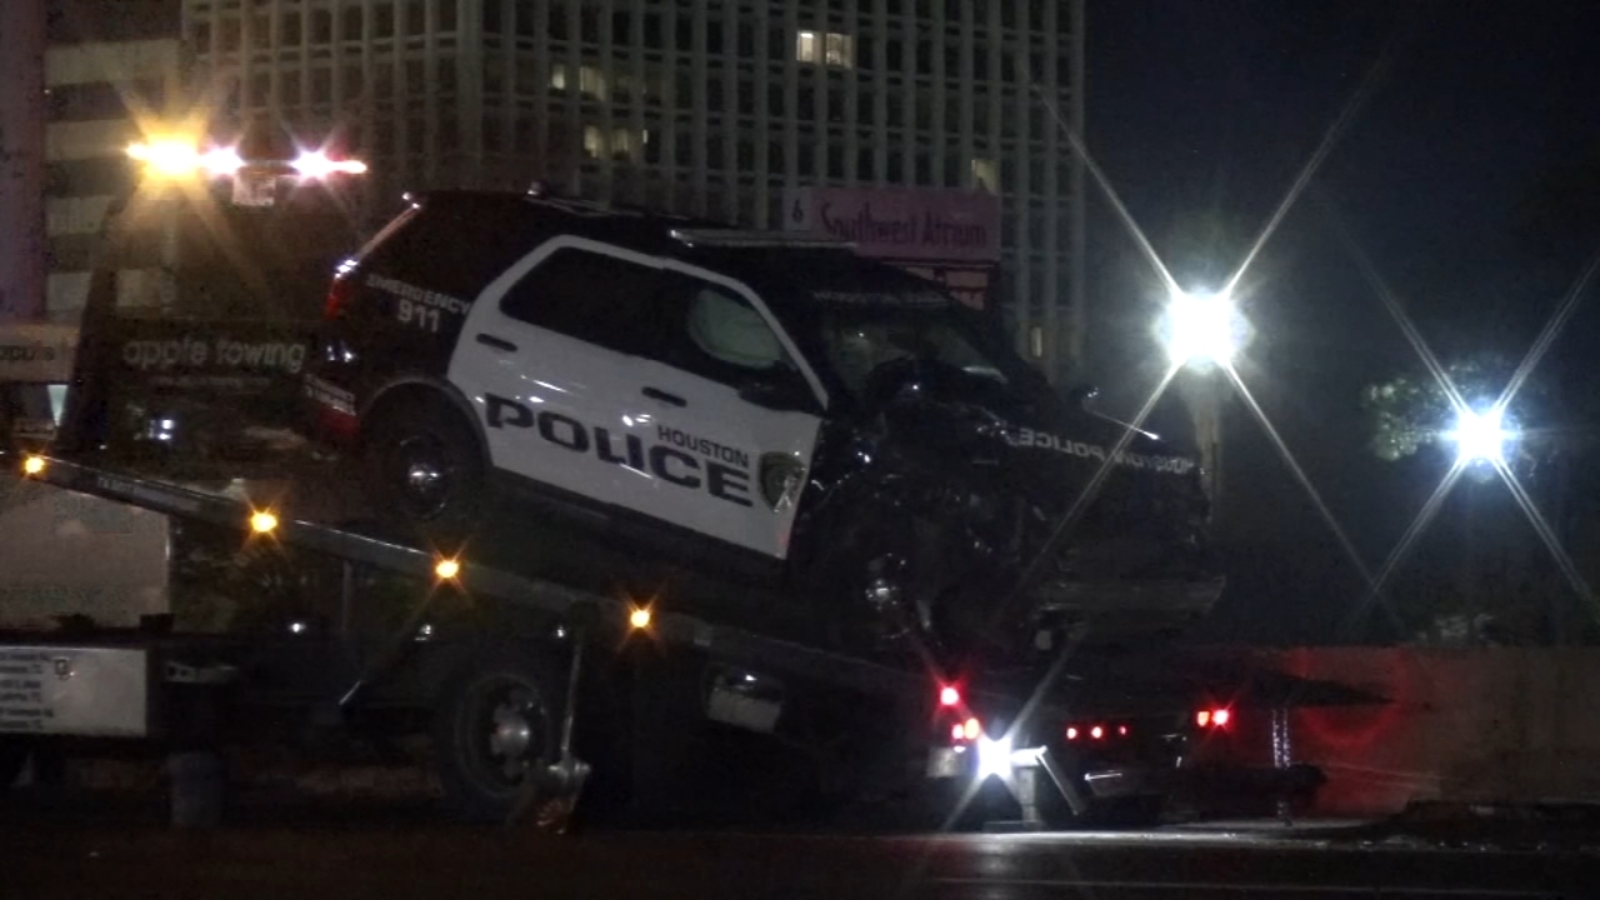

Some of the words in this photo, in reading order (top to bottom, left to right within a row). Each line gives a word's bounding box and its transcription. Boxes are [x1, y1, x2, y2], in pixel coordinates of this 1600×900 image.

[820, 201, 917, 245] Southwest
[922, 208, 988, 245] Atrium
[365, 273, 472, 315] EMERGENCY
[397, 298, 441, 333] 911
[122, 335, 208, 370] apple
[215, 338, 306, 373] towing
[485, 392, 753, 508] POLICE
[657, 424, 750, 468] HOUSTON
